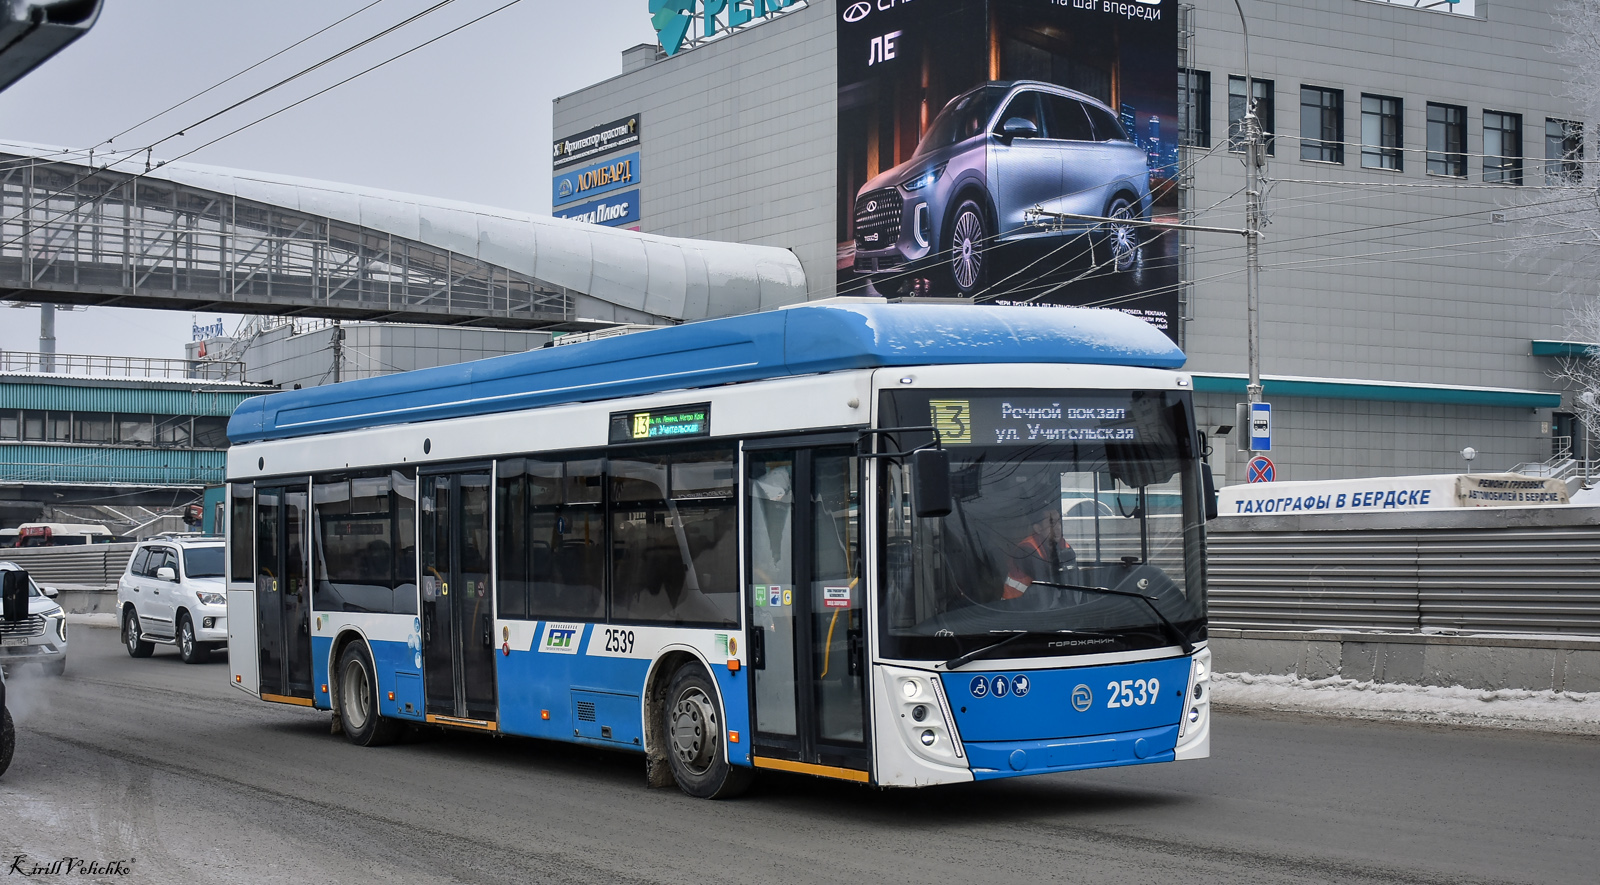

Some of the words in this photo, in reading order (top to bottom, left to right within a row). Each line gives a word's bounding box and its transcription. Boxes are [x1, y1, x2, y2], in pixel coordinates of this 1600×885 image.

[1103, 1, 1160, 21] впереди
[564, 134, 600, 155] Архитектор
[601, 125, 628, 144] красоты
[576, 160, 632, 193] ЛОМБАРД
[634, 416, 648, 435] 13
[995, 428, 1020, 444] ул.
[1027, 423, 1134, 440] Учительская
[1478, 479, 1508, 488] РЕМОНТ
[1508, 480, 1545, 489] ГРУЗОВЫХ
[1235, 494, 1332, 513] ТАХОГРАФЫ
[1335, 493, 1346, 508] В
[1351, 489, 1431, 508] БЕРДСКЕ
[1468, 490, 1517, 501] АВТОМОБИЛЕЙ
[1518, 492, 1524, 501] В
[1526, 492, 1558, 502] БЕРДСКЕ
[605, 628, 635, 654] 2539
[1048, 638, 1115, 648] ГОРОЖАНИН
[1106, 677, 1160, 709] 2539
